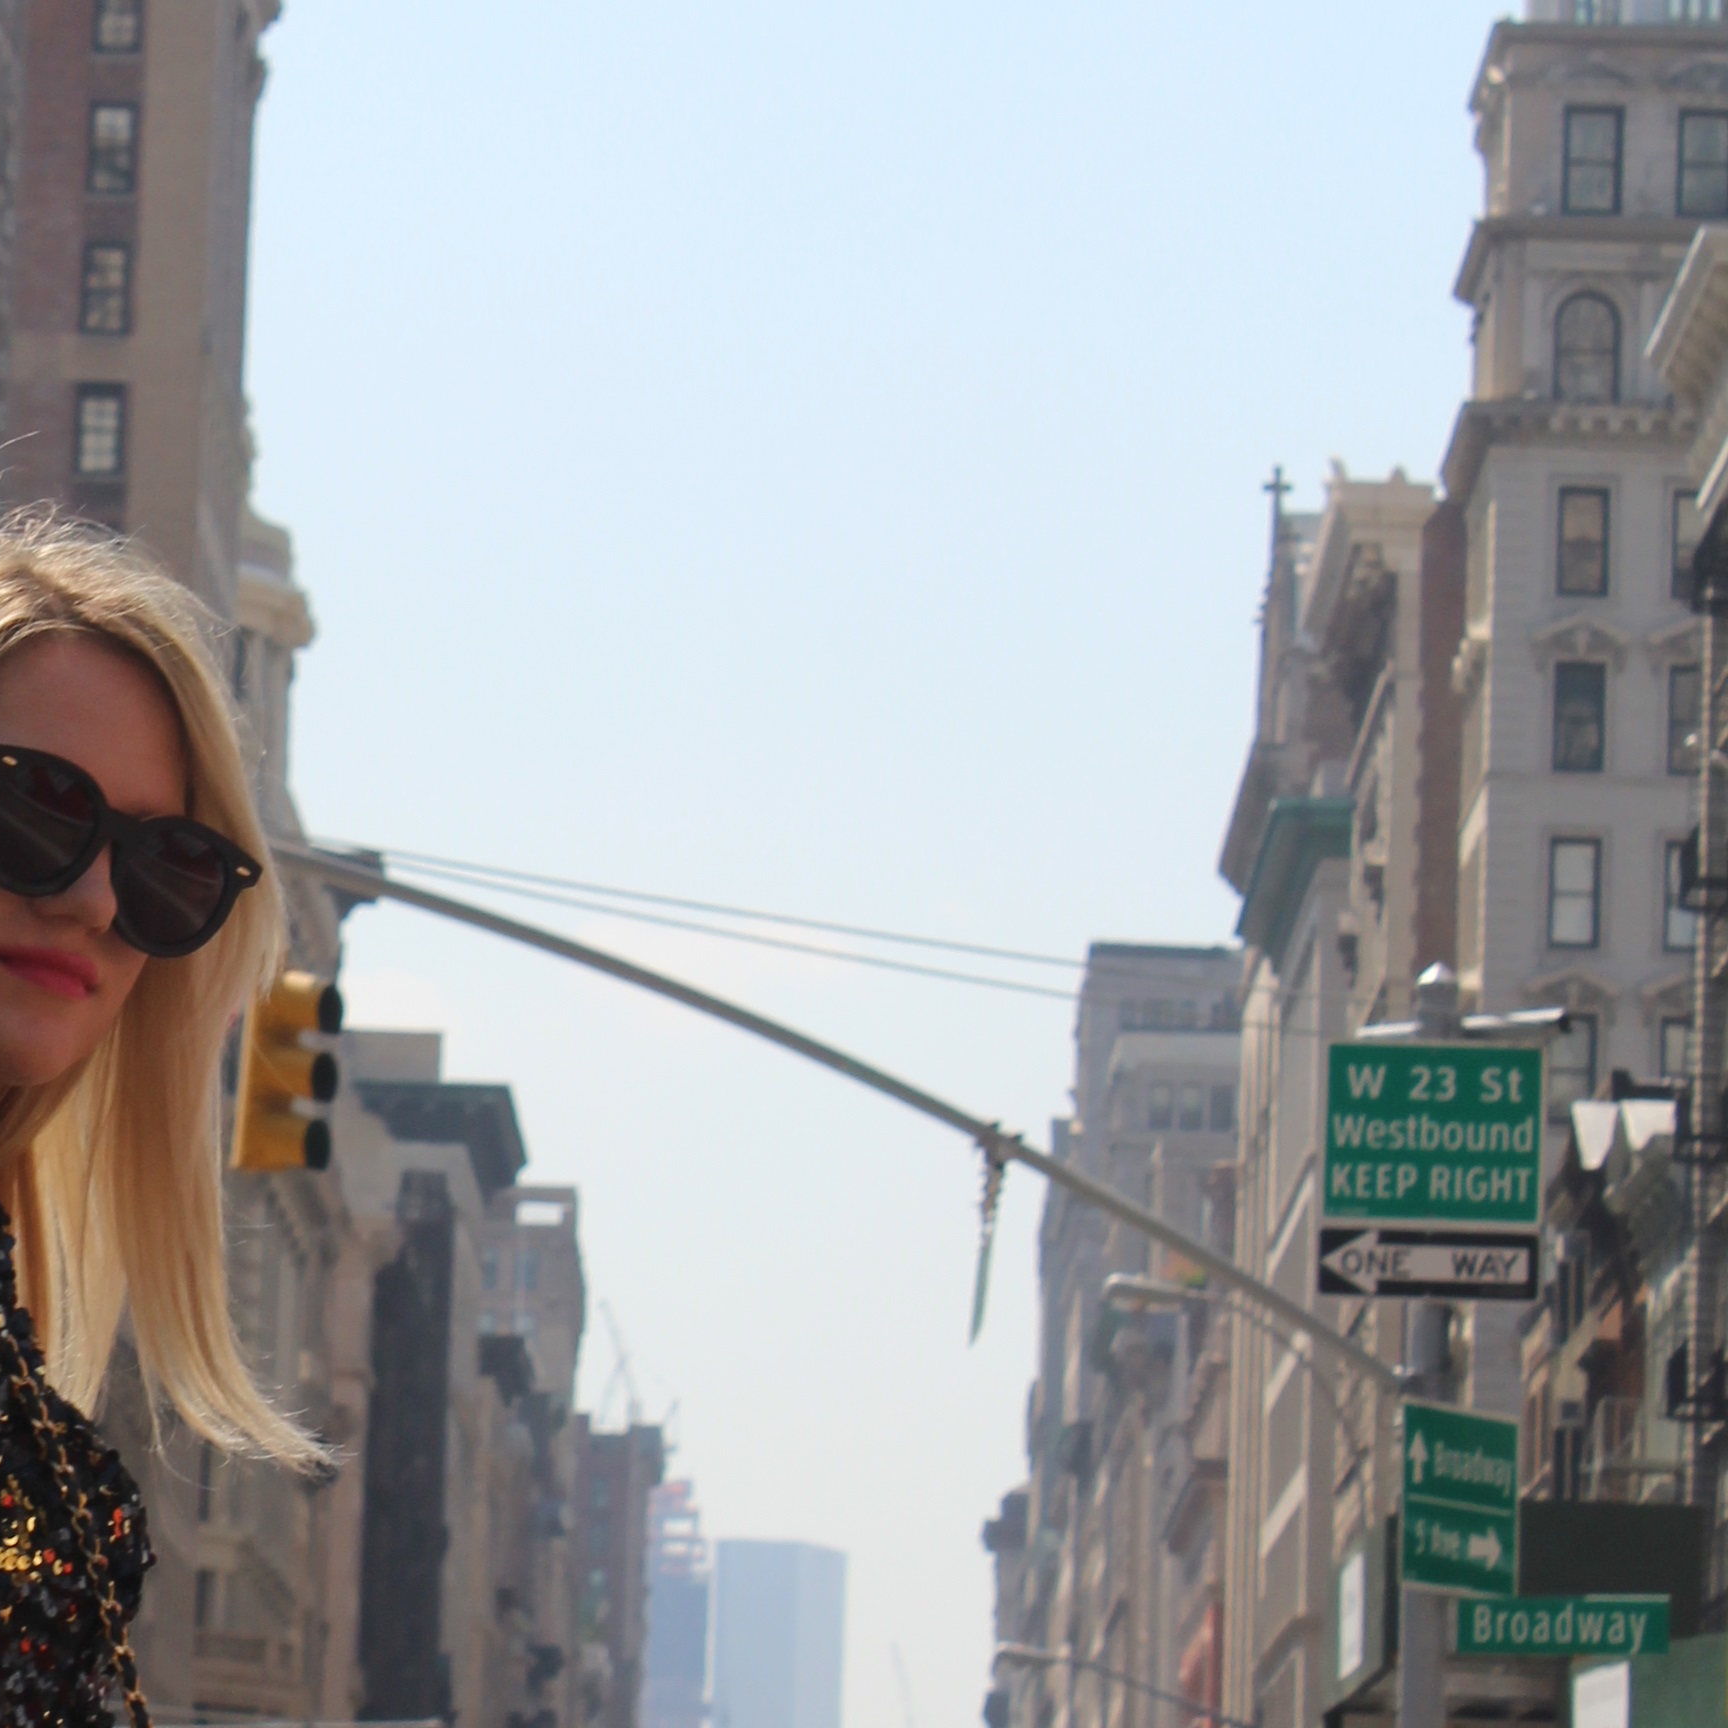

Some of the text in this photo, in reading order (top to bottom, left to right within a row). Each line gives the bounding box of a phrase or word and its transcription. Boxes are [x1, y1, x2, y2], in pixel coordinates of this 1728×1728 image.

[1348, 1064, 1522, 1104] W 23 St
[1332, 1113, 1535, 1153] Westbound
[1331, 1163, 1532, 1203] KEEP RIGHT
[1341, 1248, 1519, 1281] ONE WAY
[1474, 1604, 1648, 1655] Broadway
